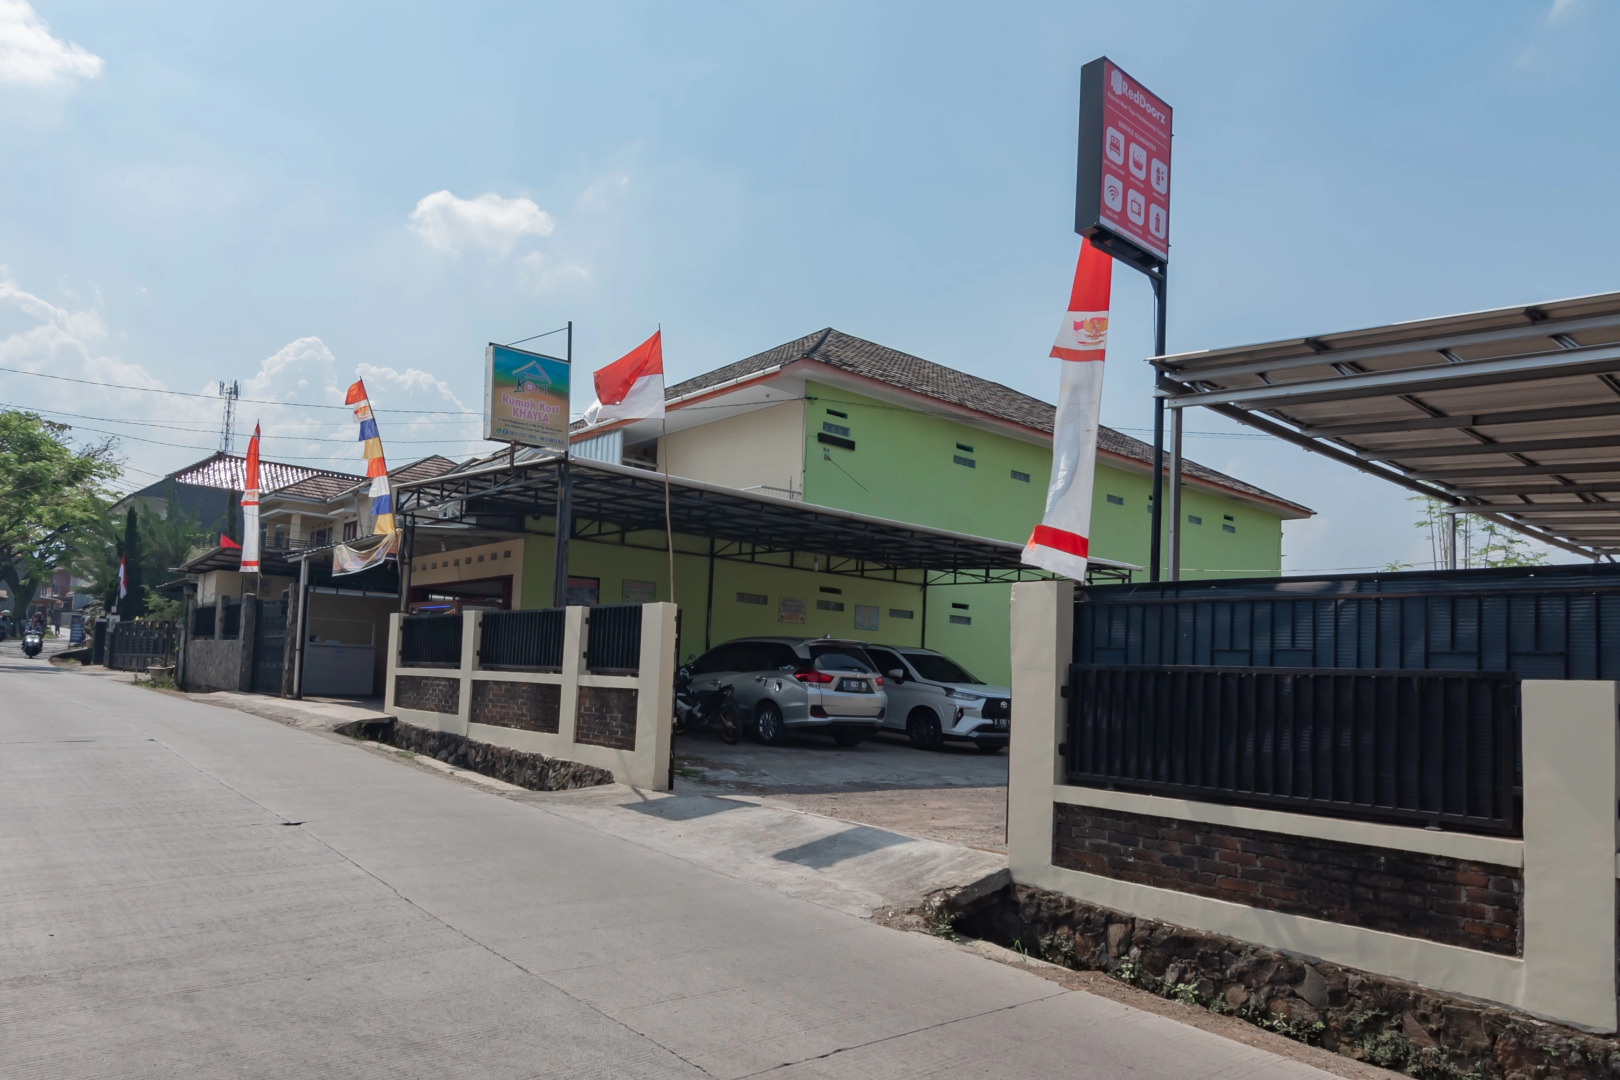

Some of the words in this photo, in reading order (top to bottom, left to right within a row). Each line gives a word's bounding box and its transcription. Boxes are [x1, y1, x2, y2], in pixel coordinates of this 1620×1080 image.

[1122, 80, 1166, 125] RedDoorz
[502, 393, 536, 410] Rumah
[512, 407, 549, 423] KHAYLA
